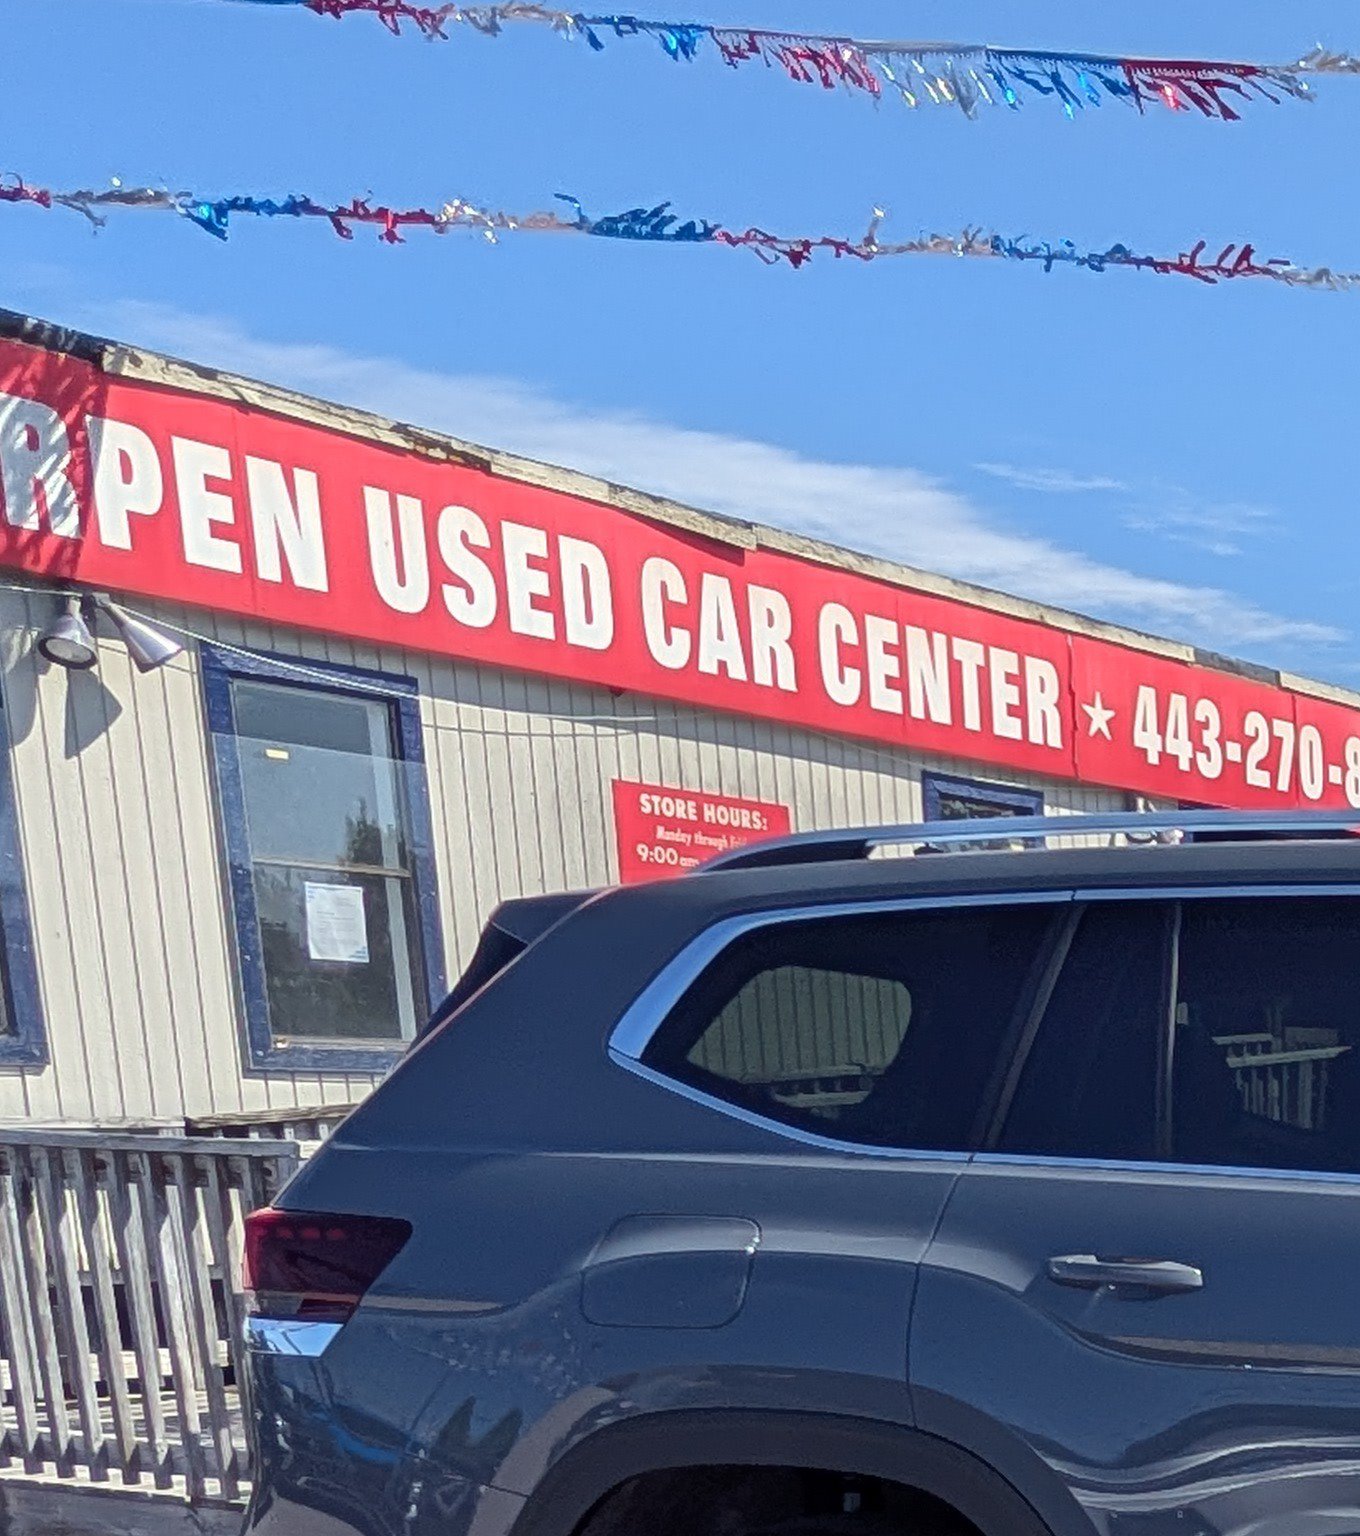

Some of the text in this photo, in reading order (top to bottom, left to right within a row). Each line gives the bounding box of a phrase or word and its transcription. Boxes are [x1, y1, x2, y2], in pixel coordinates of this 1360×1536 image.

[363, 485, 614, 650] USED
[641, 557, 798, 692] CAR
[818, 602, 1063, 749] CENTER
[639, 793, 768, 831] STORE HOURS:
[656, 825, 692, 847] Monday
